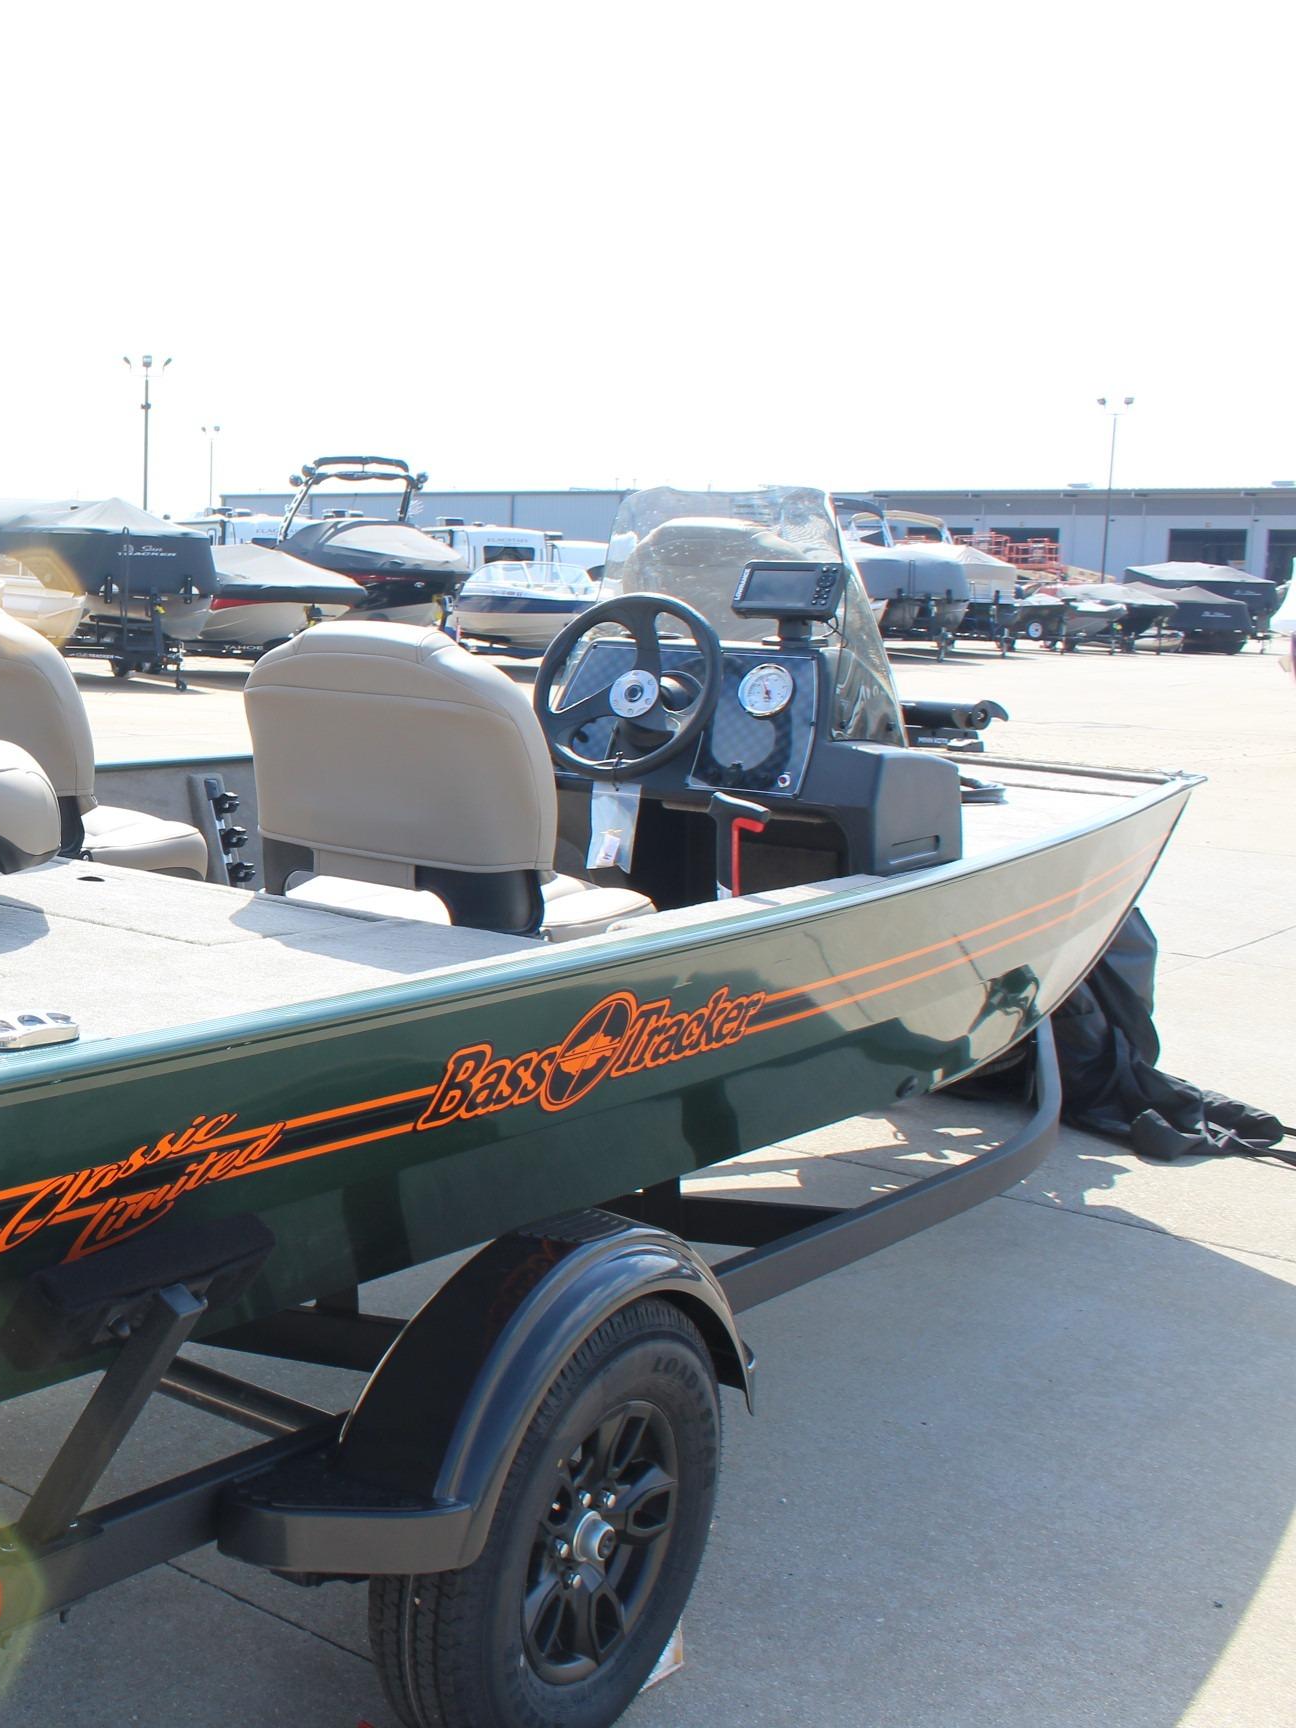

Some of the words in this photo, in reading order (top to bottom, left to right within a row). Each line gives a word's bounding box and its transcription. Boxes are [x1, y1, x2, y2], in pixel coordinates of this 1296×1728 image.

[416, 1041, 560, 1131] Bass
[610, 984, 768, 1078] Tracker
[59, 1120, 286, 1265] Limited
